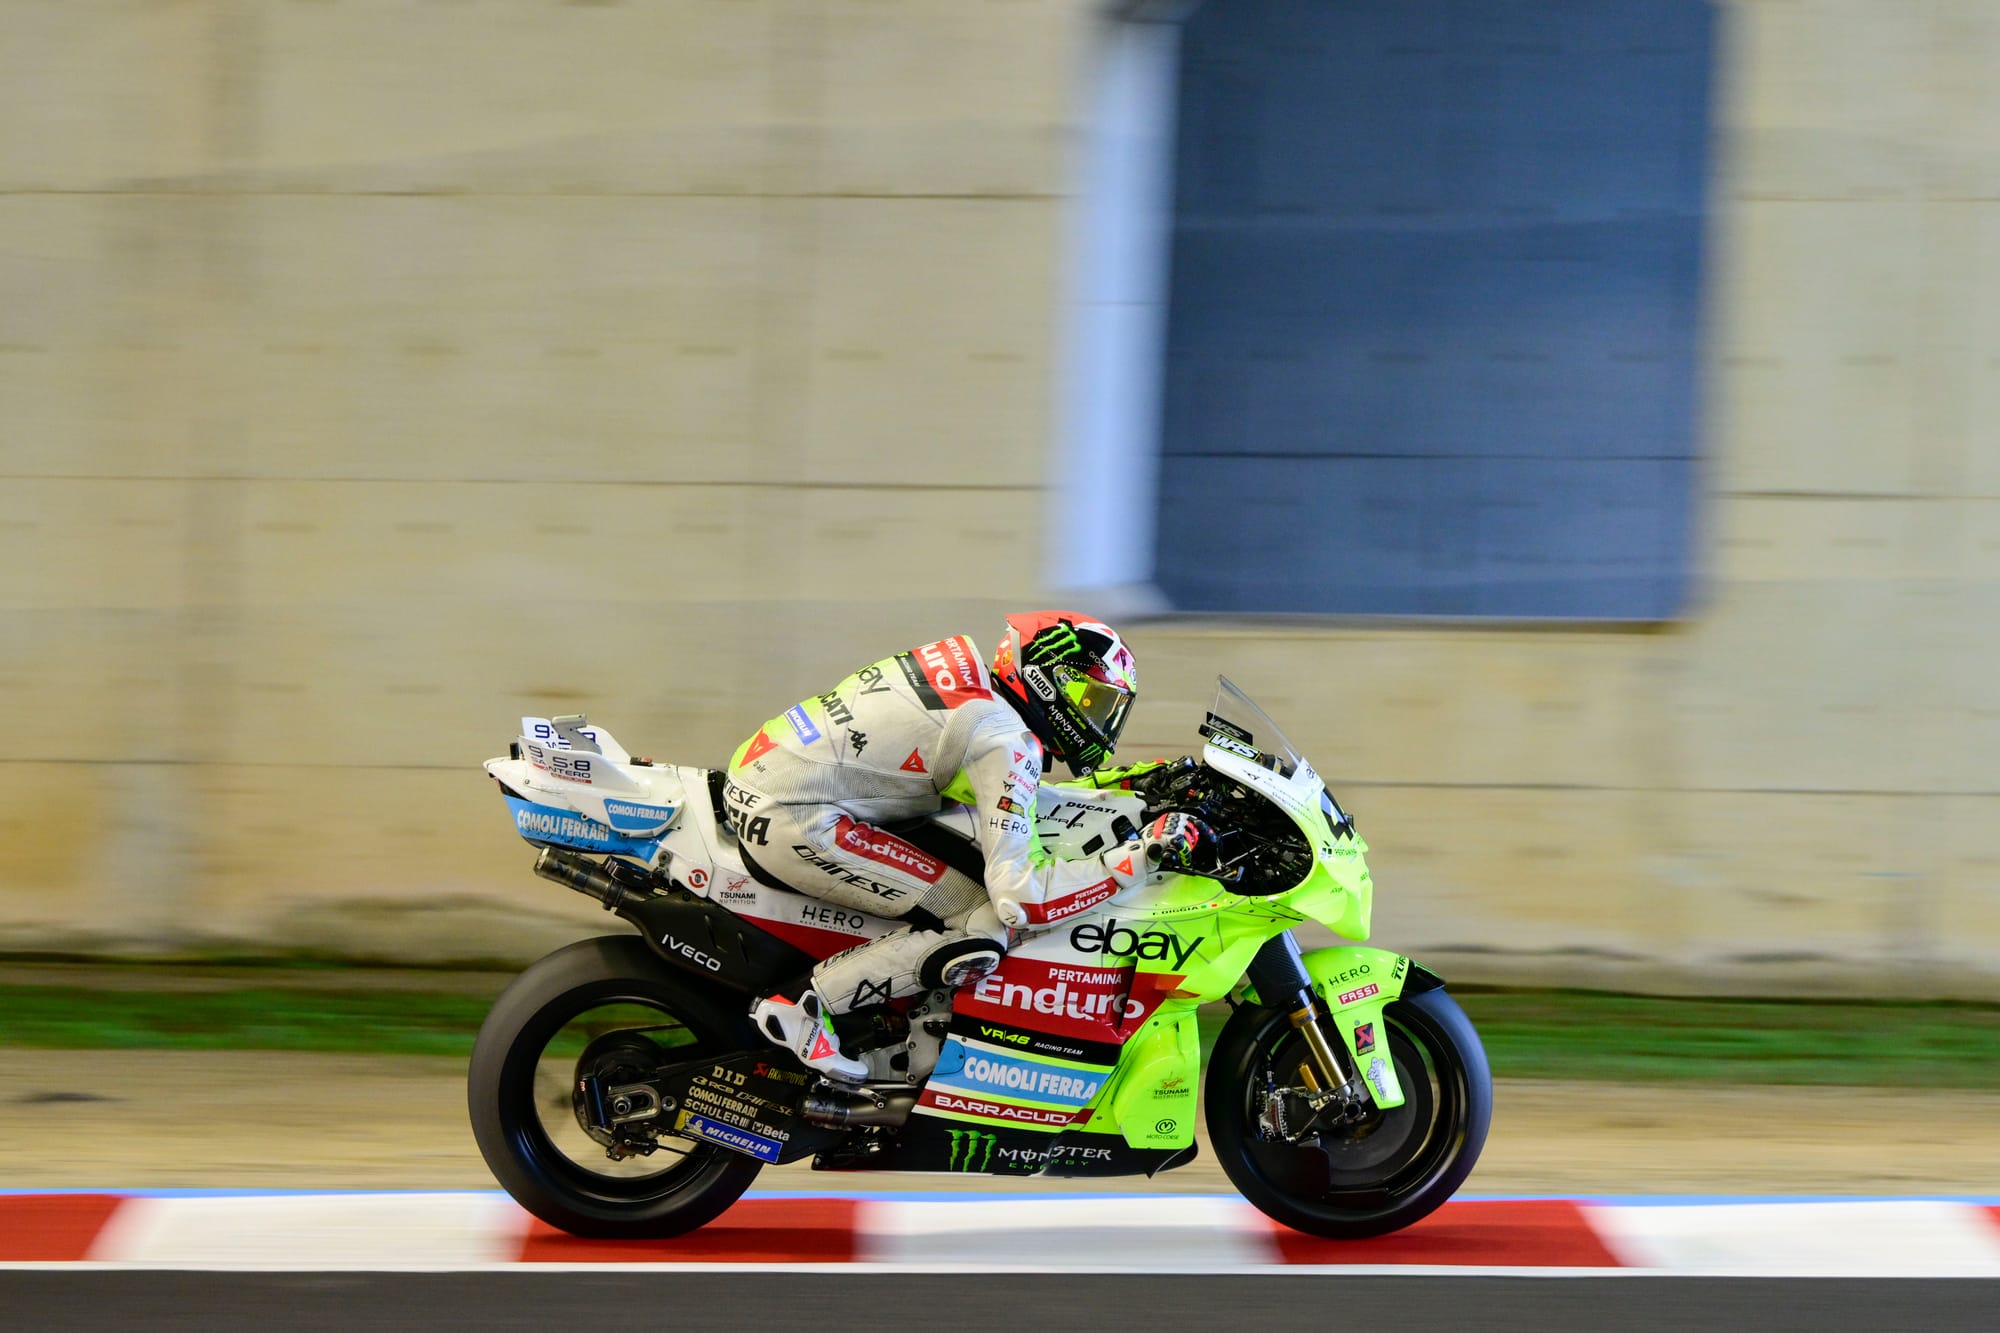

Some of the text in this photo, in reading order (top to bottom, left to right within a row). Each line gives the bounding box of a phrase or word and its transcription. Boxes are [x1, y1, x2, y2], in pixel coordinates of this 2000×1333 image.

[1028, 669, 1053, 698] SHOEI
[818, 691, 854, 726] CATI
[608, 803, 669, 822] COMOLI FERRARI
[1066, 801, 1117, 814] DUCATI
[517, 809, 610, 841] COMOLI FERRARI
[989, 817, 1028, 834] HERO
[845, 830, 936, 876] Enduro
[888, 840, 937, 866] PERTAMINA
[720, 891, 756, 900] TSUNAMI
[1046, 891, 1109, 920] Enduro
[802, 905, 864, 929] HERO
[661, 934, 721, 972] IVECO
[1070, 918, 1205, 971] ebay
[1048, 968, 1122, 985] PERTAMINA
[1328, 965, 1370, 986] HERO
[973, 974, 1145, 1021] Enduro
[1341, 985, 1377, 1003] FASSI
[1034, 1042, 1062, 1053] RACING
[1063, 1047, 1084, 1056] TEAM
[964, 1056, 1038, 1091] COMOLI
[688, 1086, 757, 1118] COMOLI FERRARI
[705, 1126, 771, 1154] MICHELIN
[762, 1125, 790, 1141] Beta
